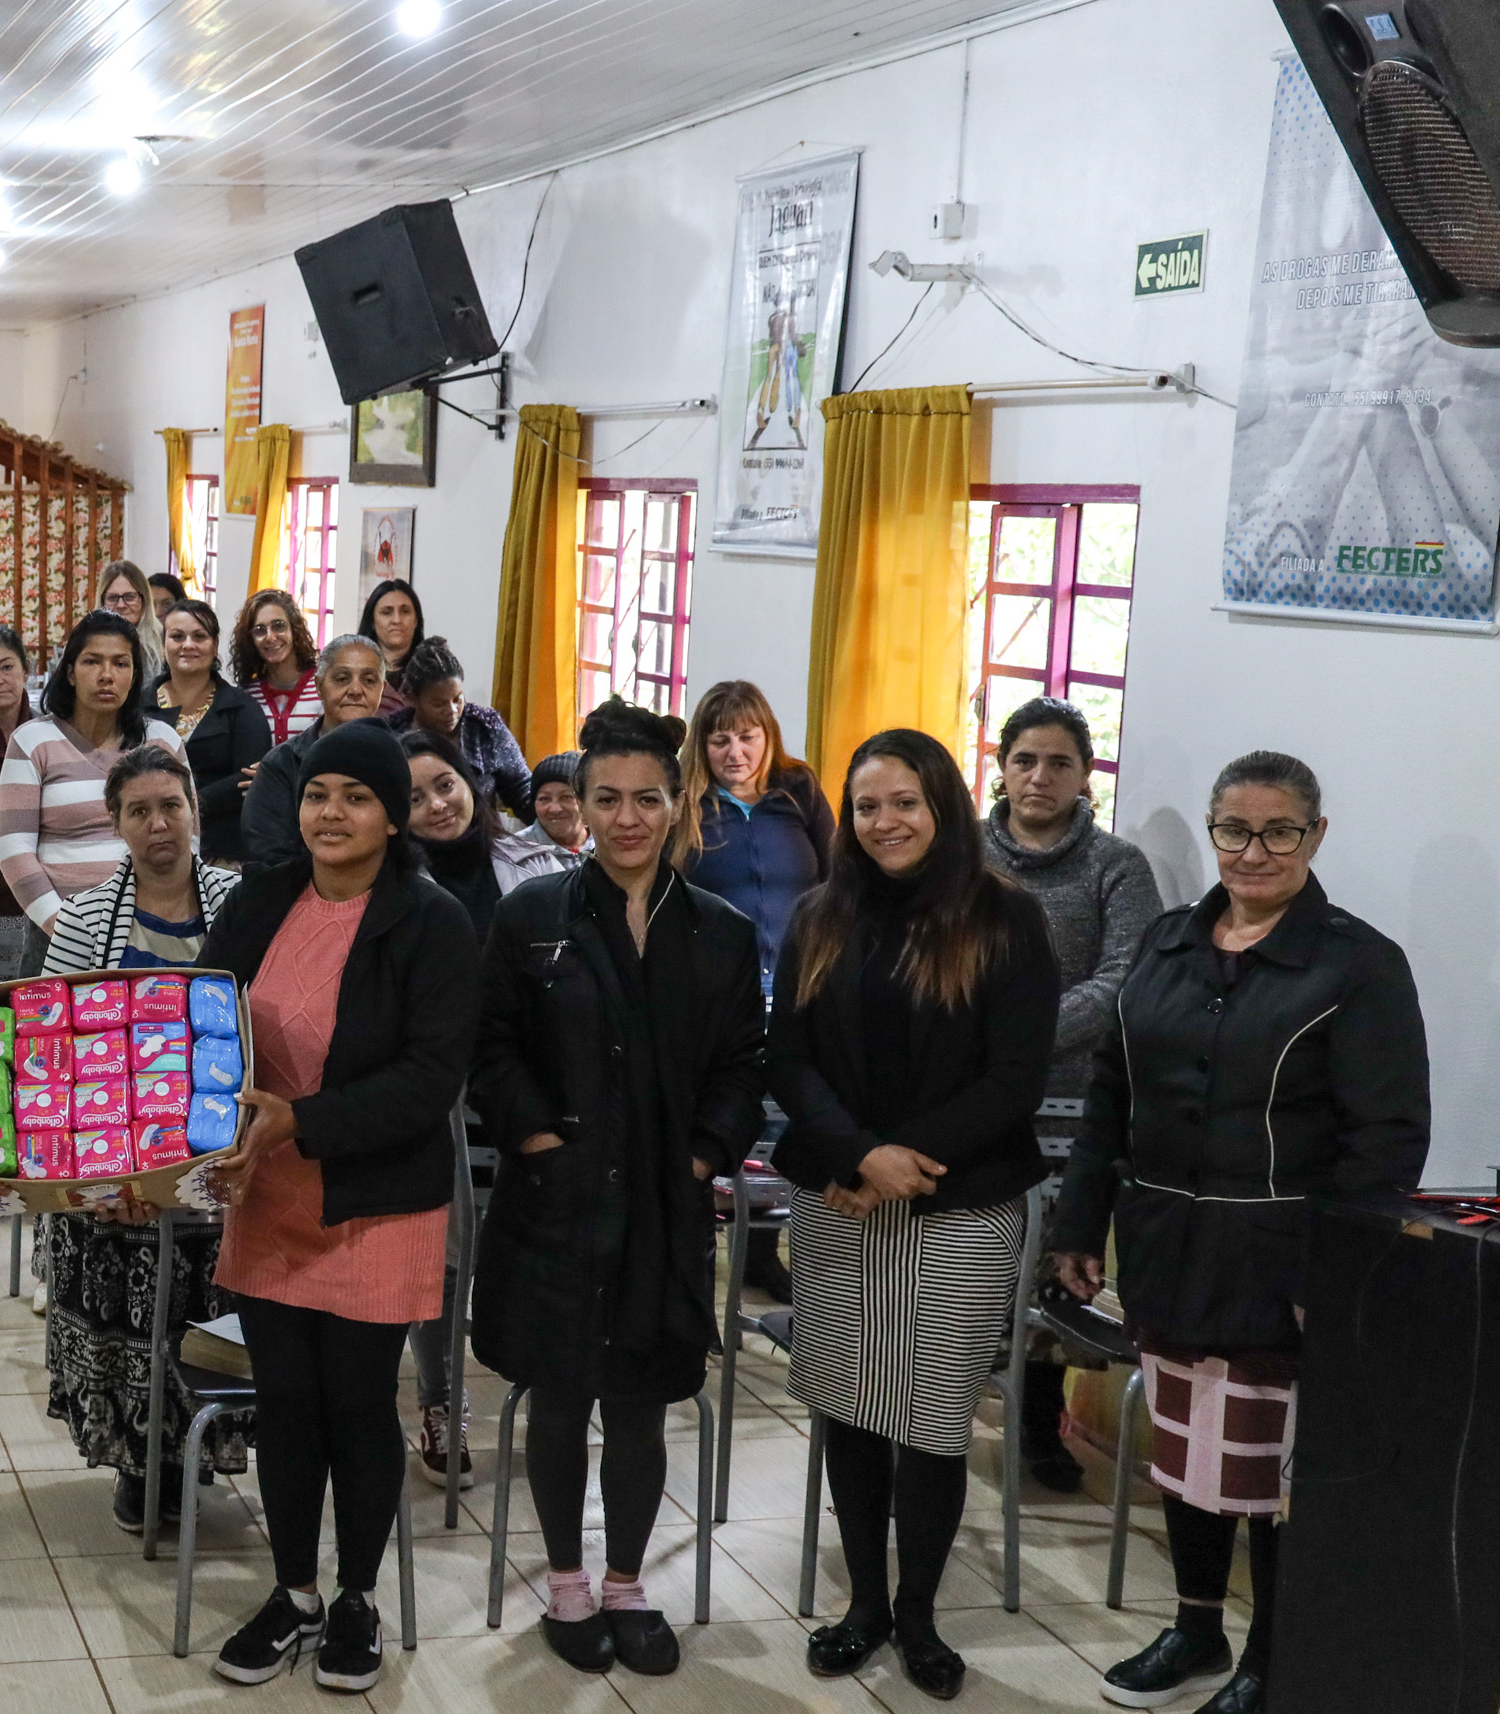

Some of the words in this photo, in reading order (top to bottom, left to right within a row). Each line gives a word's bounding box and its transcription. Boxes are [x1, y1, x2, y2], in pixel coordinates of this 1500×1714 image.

[1156, 241, 1200, 290] SAÍDA
[1262, 262, 1279, 283] AS
[1280, 256, 1330, 281] DROGAS
[1330, 253, 1350, 276] ME
[1296, 286, 1342, 310] DEPOIS
[1343, 283, 1364, 306] ME
[1281, 556, 1315, 573] FILIADA
[1317, 559, 1325, 573] A
[1336, 545, 1444, 575] FECTERS
[19, 989, 52, 1001] Intimus
[143, 1003, 177, 1012] Intimus
[80, 1008, 122, 1023] Cottonbaby
[53, 1038, 62, 1069] Intimus
[81, 1061, 123, 1076] Cottonbaby
[22, 1115, 65, 1127] Cottonbaby
[80, 1111, 123, 1126] Cottonbaby
[51, 1135, 60, 1167] Intimus
[152, 1149, 188, 1161] Intimus
